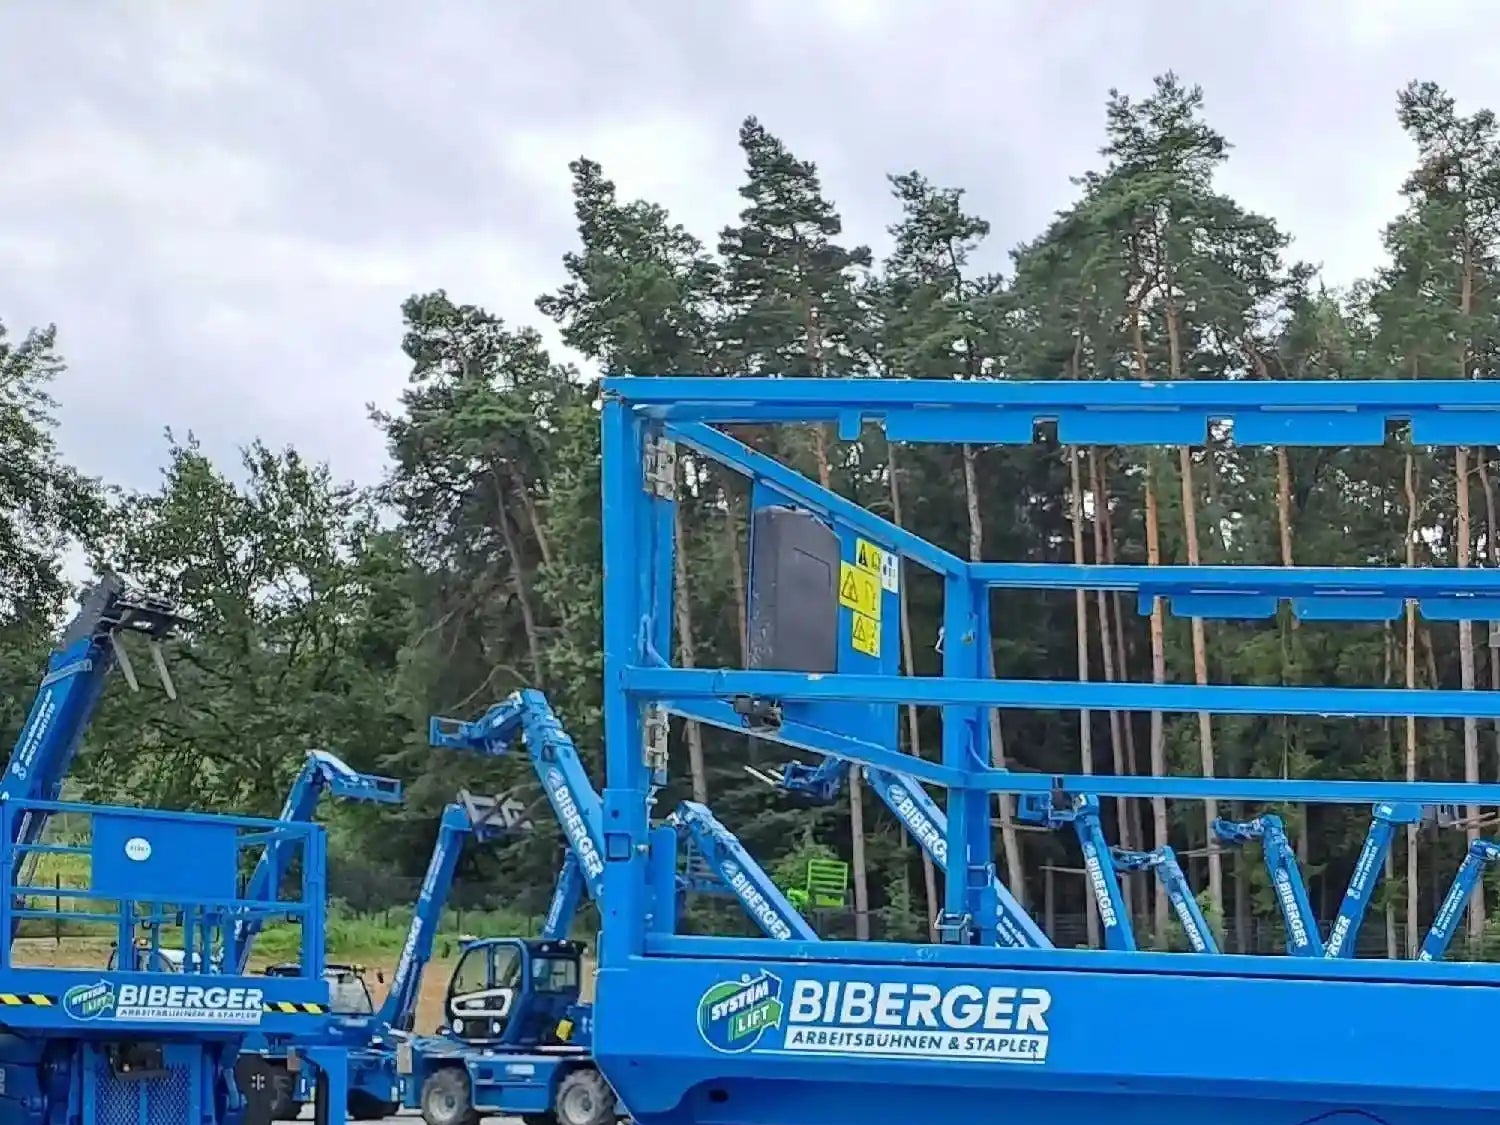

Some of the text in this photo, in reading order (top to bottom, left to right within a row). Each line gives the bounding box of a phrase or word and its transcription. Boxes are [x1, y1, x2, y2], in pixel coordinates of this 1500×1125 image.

[555, 785, 604, 878] BIBERGER
[732, 872, 791, 940] BIBERGER
[1086, 857, 1118, 929] BIBERGER
[1280, 881, 1308, 948] BIBERGER
[118, 984, 263, 1008] BIBERGER
[711, 980, 769, 1021] SYSTEM
[738, 1004, 770, 1032] LIFT
[789, 979, 1051, 1032] BIBERGER
[792, 1030, 1040, 1053] ARBEITSBÜHNEN & STAPLER
